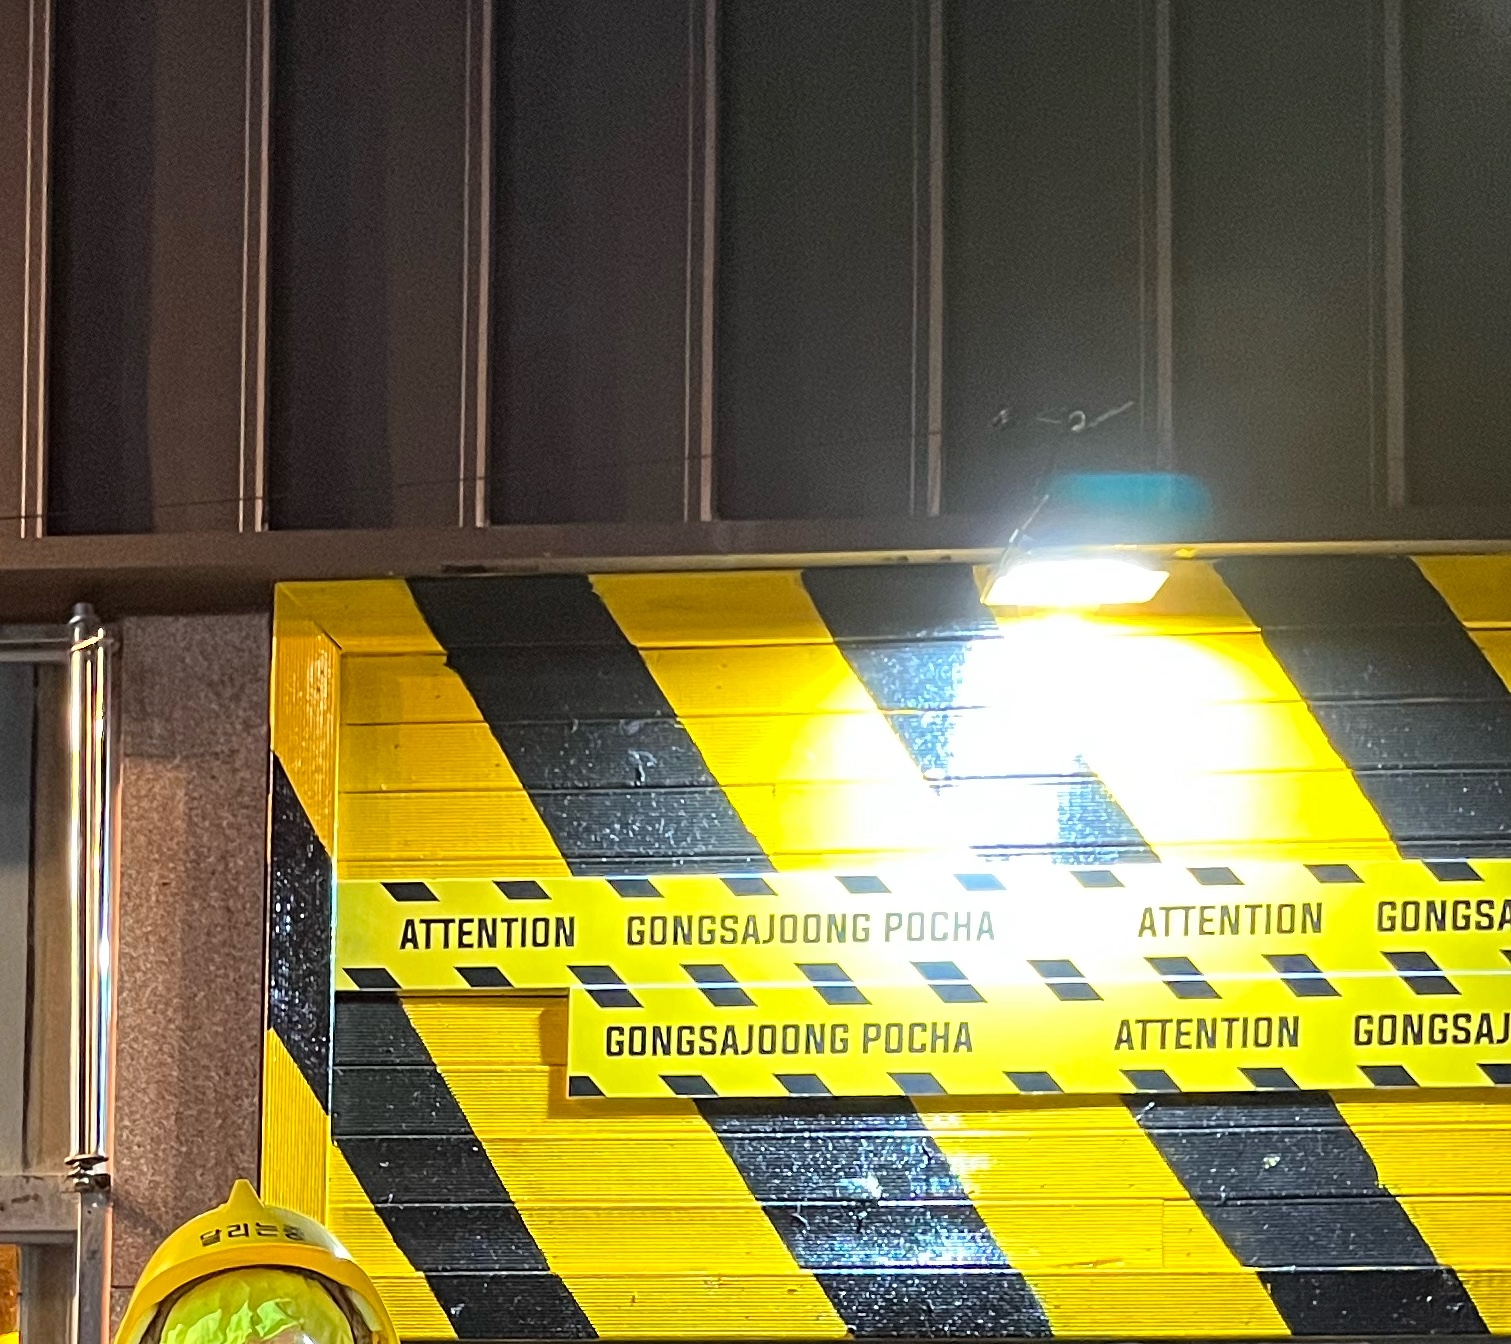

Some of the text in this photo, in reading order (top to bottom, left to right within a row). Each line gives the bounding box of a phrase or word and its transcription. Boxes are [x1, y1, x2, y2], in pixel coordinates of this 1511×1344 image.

[399, 915, 576, 951] ATTENTION
[626, 912, 871, 947] GONGSAJOONG
[883, 909, 996, 944] POCHA
[1137, 901, 1324, 939] ATTENTION
[605, 1022, 850, 1058] GONGSAJOONG
[861, 1020, 974, 1055] POCHA
[1113, 1014, 1301, 1052] ATTENTION
